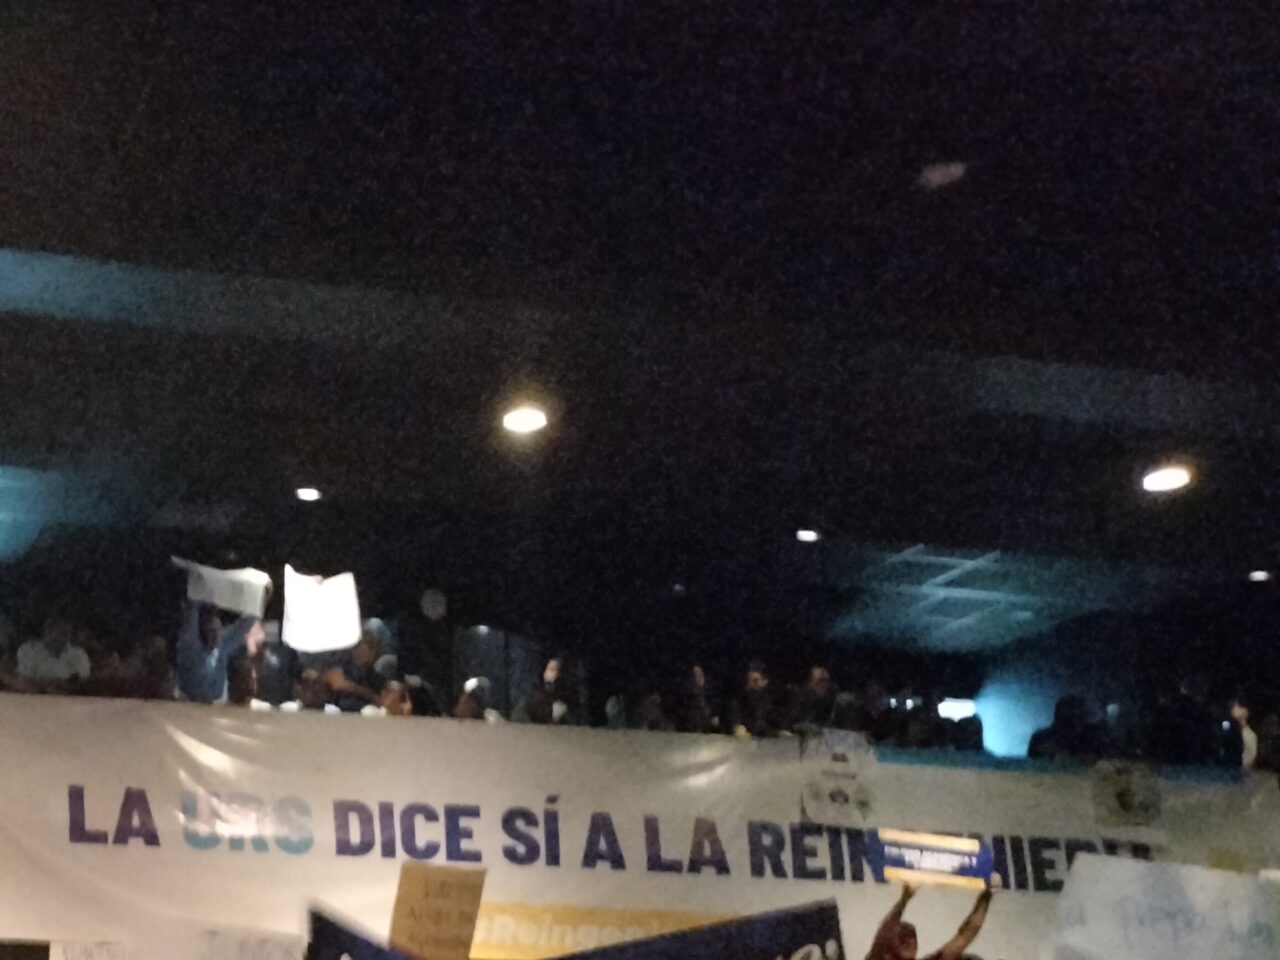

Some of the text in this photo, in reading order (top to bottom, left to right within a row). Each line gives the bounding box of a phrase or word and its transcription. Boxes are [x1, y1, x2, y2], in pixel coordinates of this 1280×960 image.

[67, 783, 161, 848] LA
[331, 799, 483, 864] DICE
[501, 794, 561, 867] SÍ
[580, 811, 628, 871] A
[643, 814, 731, 876] LA
